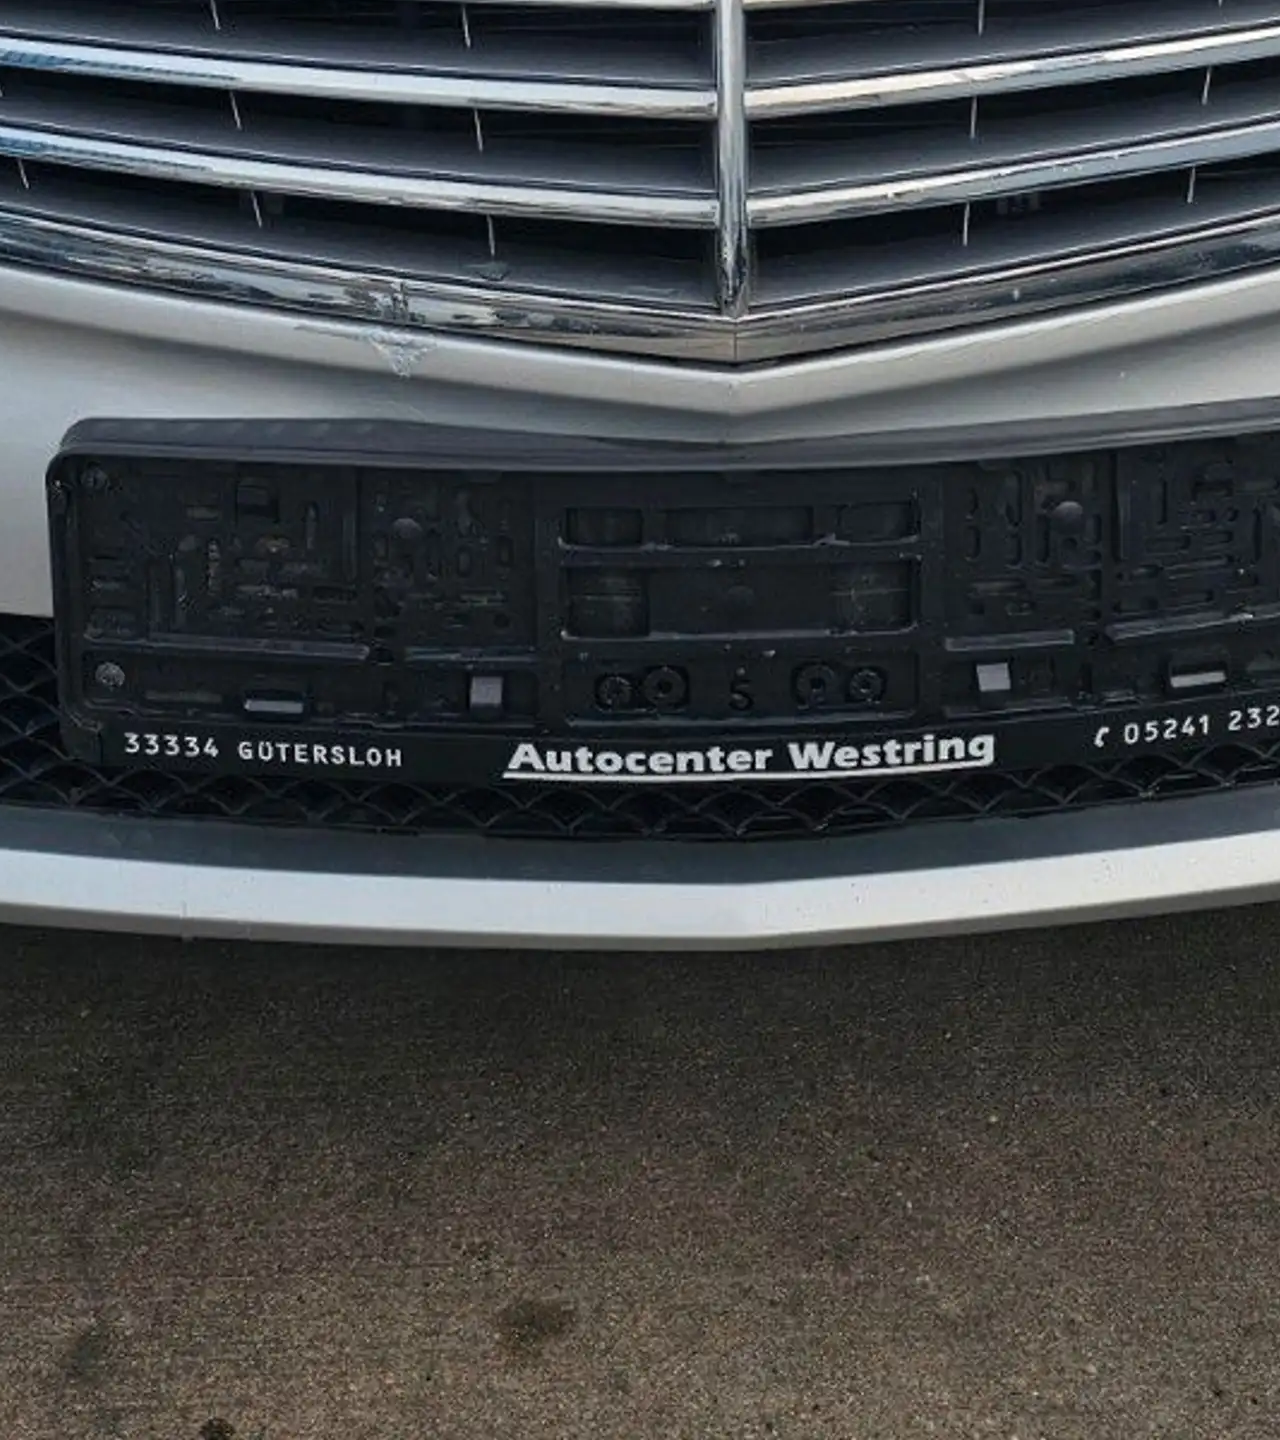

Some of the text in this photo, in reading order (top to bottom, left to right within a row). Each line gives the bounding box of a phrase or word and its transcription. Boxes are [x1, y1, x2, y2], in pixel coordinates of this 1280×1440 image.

[124, 731, 219, 758] 33334
[1123, 714, 1210, 745] 05241
[508, 734, 996, 774] Autocenter Westring
